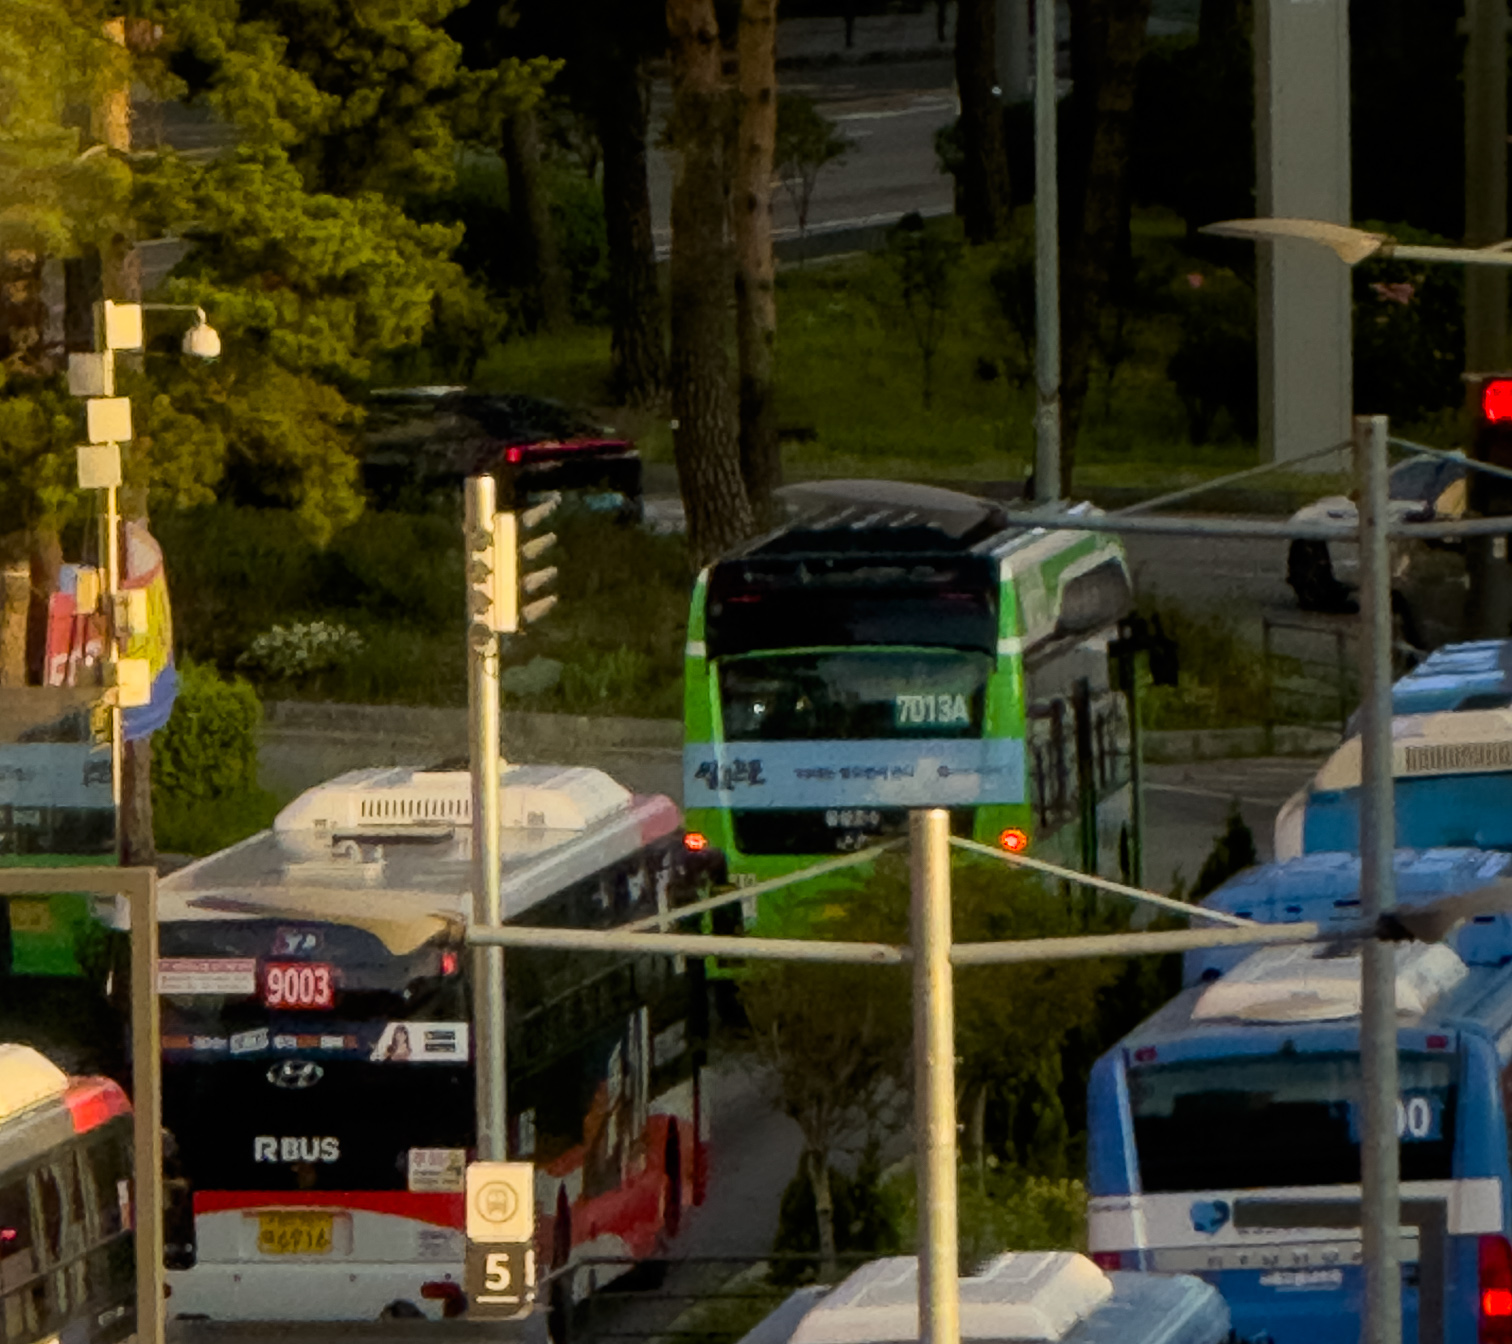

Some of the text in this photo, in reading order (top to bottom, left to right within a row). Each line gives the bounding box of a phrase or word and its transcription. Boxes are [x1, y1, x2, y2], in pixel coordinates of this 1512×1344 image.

[897, 696, 970, 723] 7013A
[266, 967, 332, 1006] 9003
[484, 1252, 511, 1291] 5
